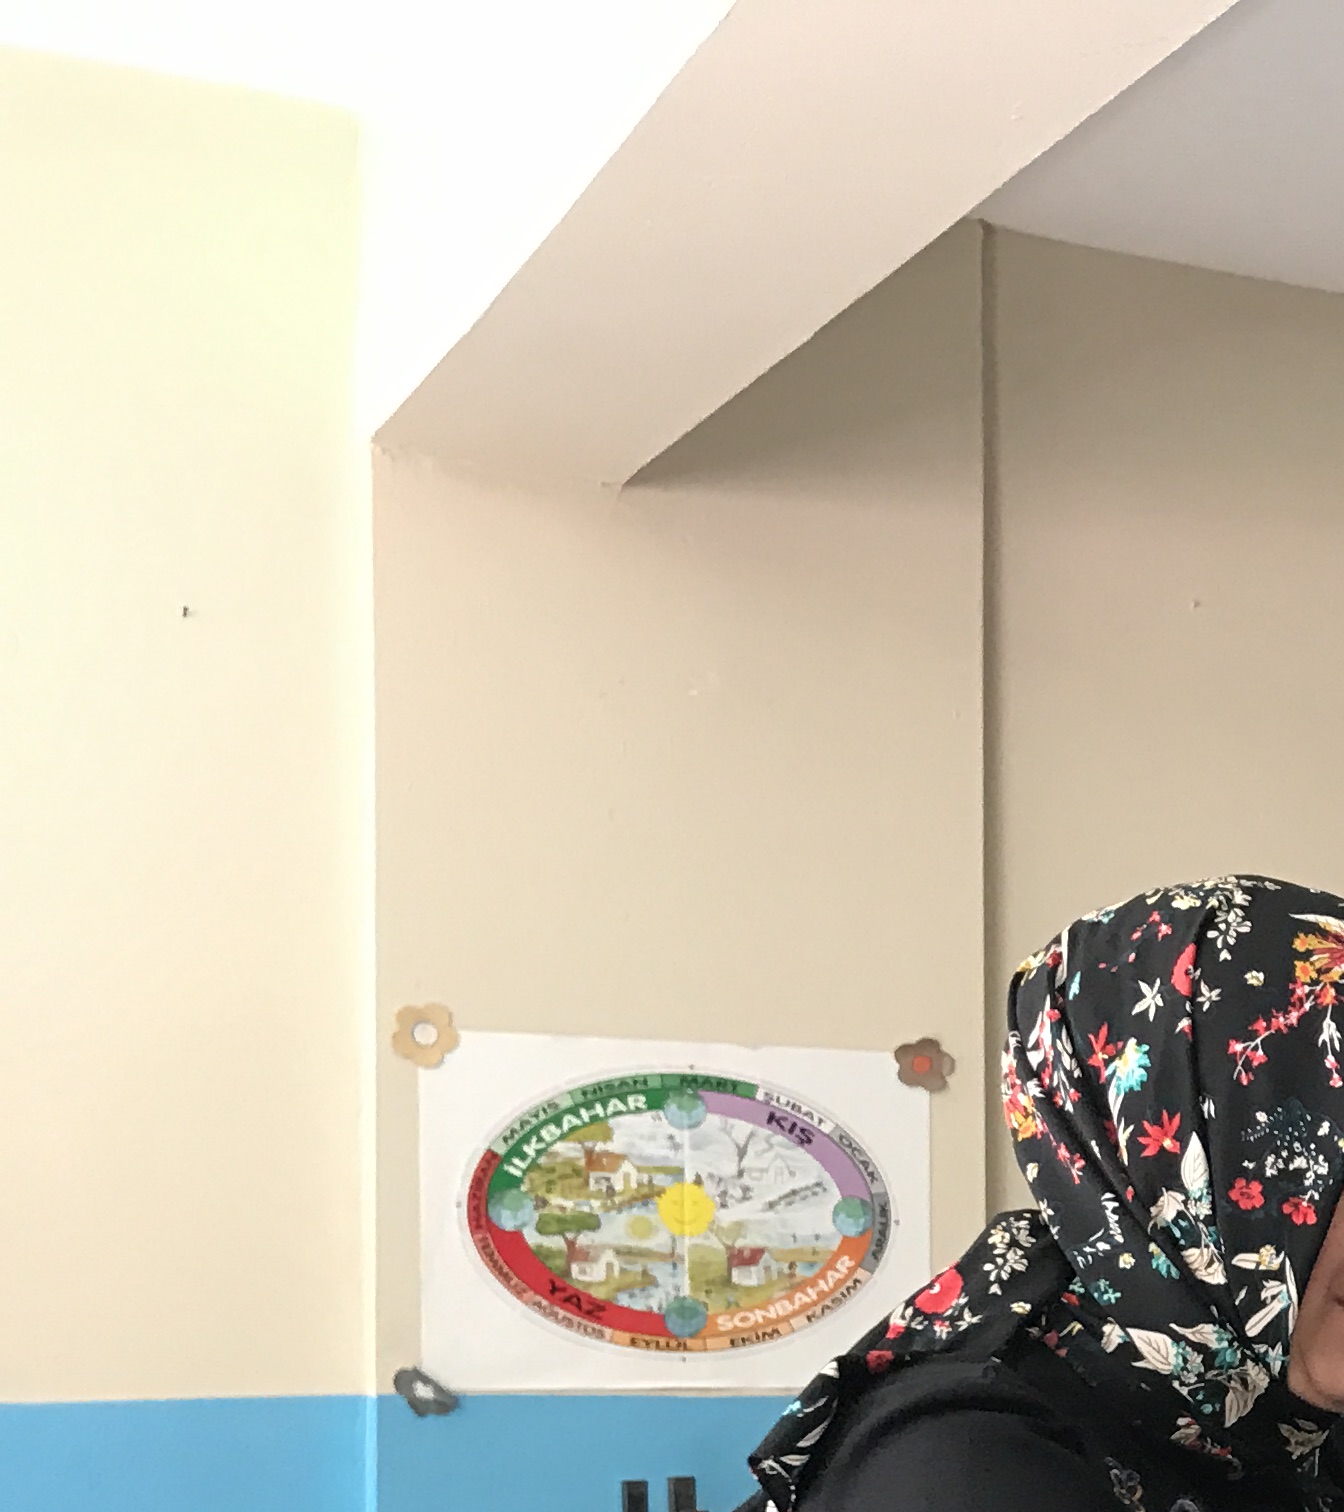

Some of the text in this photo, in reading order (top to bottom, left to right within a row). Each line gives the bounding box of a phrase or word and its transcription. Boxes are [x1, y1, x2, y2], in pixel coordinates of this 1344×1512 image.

[502, 1101, 560, 1146] MAYIS
[503, 1093, 648, 1178] İLKBAHAR
[766, 1111, 815, 1147] KIŞ
[838, 1132, 879, 1184] OCAK
[549, 1278, 606, 1320] YAZ
[716, 1255, 855, 1331] SONBAHAR
[806, 1277, 862, 1323] KASIM
